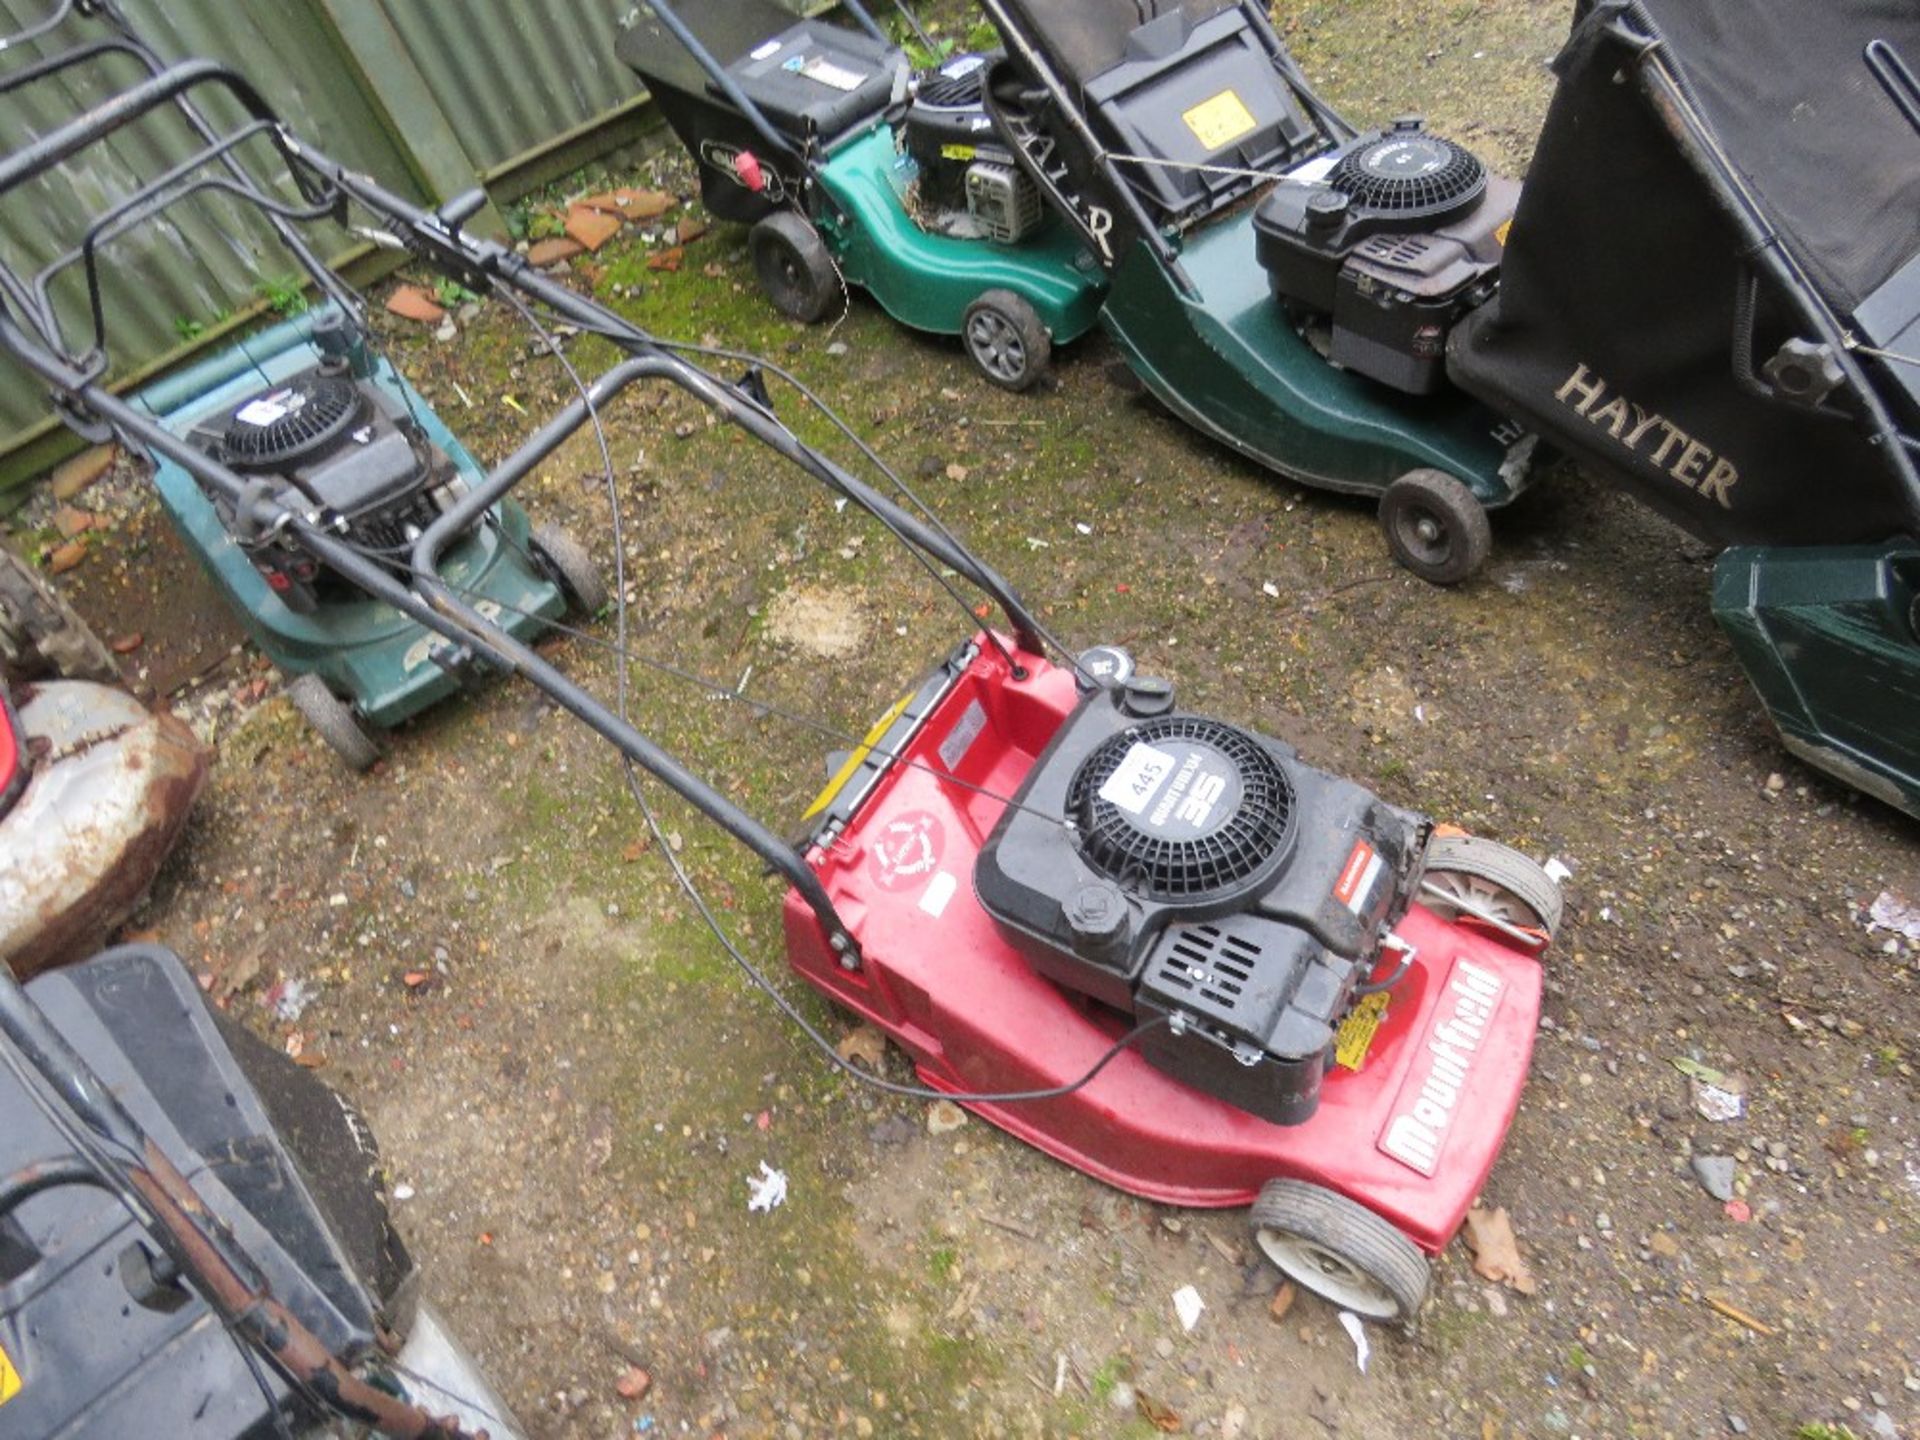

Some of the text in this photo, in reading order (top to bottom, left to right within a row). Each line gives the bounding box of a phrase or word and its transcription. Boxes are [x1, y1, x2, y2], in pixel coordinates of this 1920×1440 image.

[1554, 361, 1739, 511] HAYTER
[1131, 762, 1163, 797] 445
[1174, 771, 1227, 829] 35
[1384, 959, 1502, 1171] Mountfield
